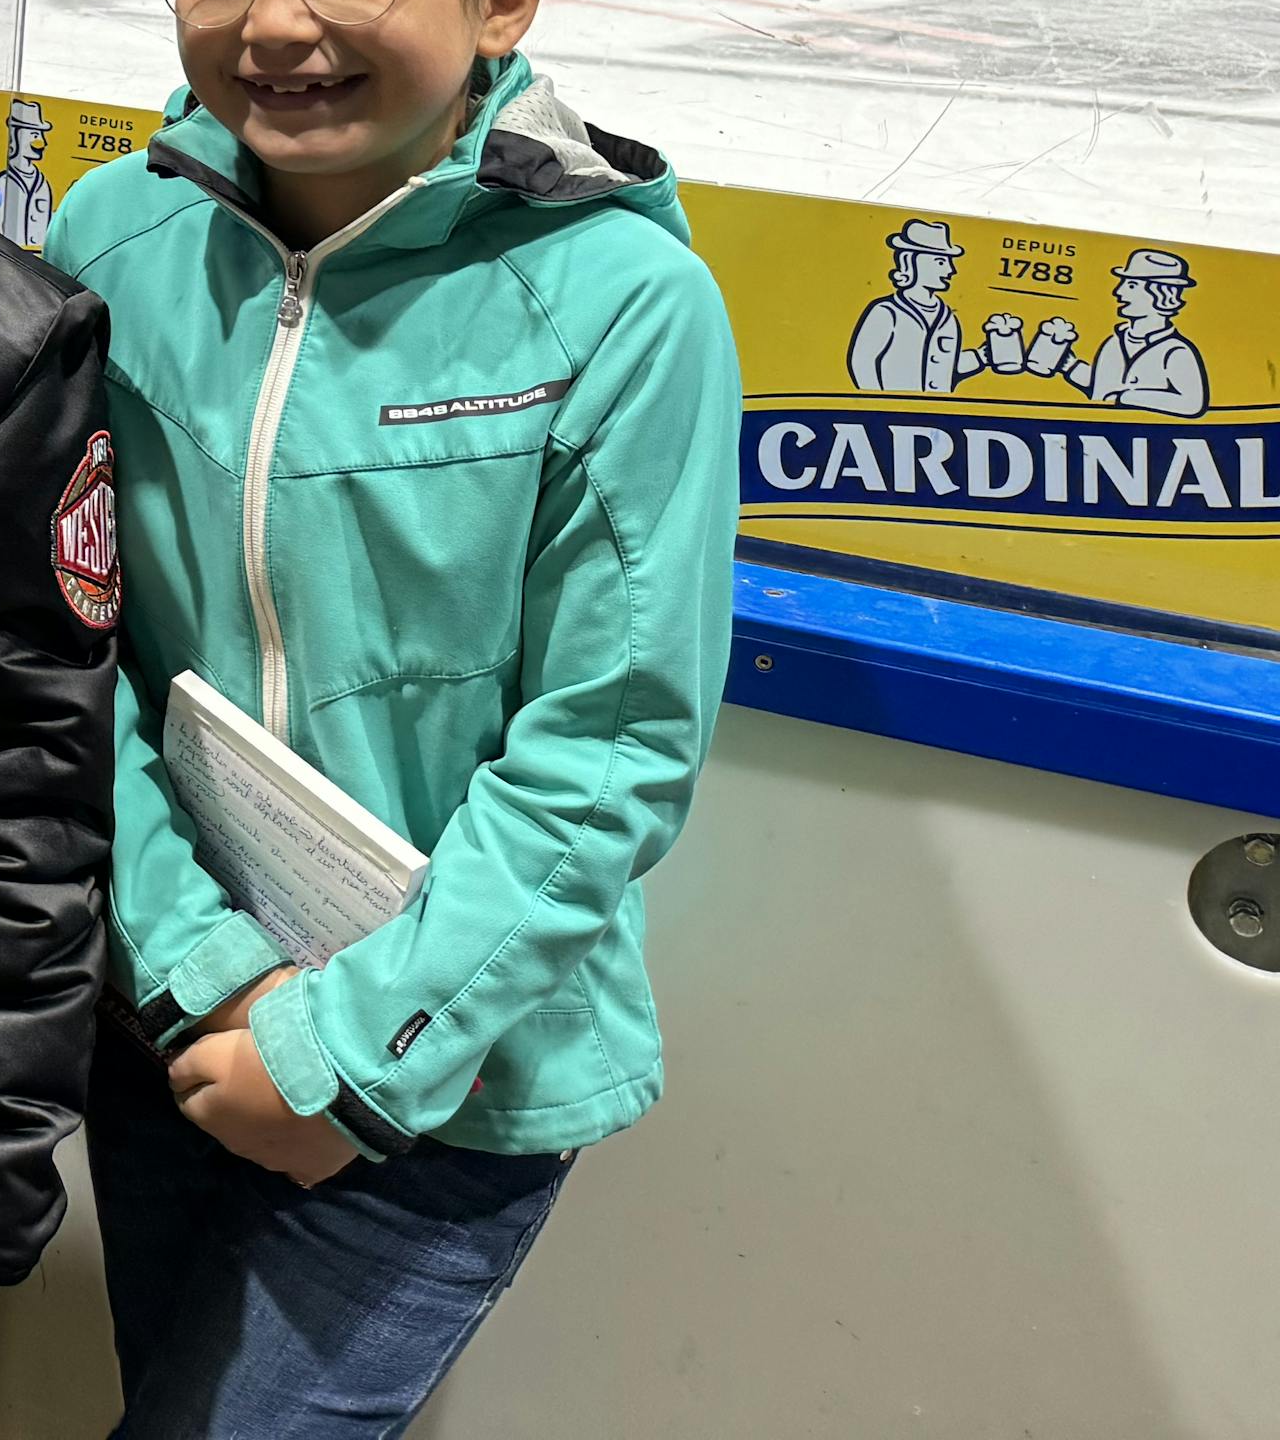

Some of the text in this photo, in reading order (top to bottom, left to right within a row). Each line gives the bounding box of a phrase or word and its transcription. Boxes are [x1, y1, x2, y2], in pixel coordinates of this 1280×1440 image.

[79, 114, 134, 131] DEPUIS
[77, 131, 132, 154] 1788
[1002, 236, 1077, 257] DEPUIS
[998, 256, 1074, 286] 1788
[449, 387, 547, 413] ALTITUDE
[757, 420, 1280, 509] CARDINAL
